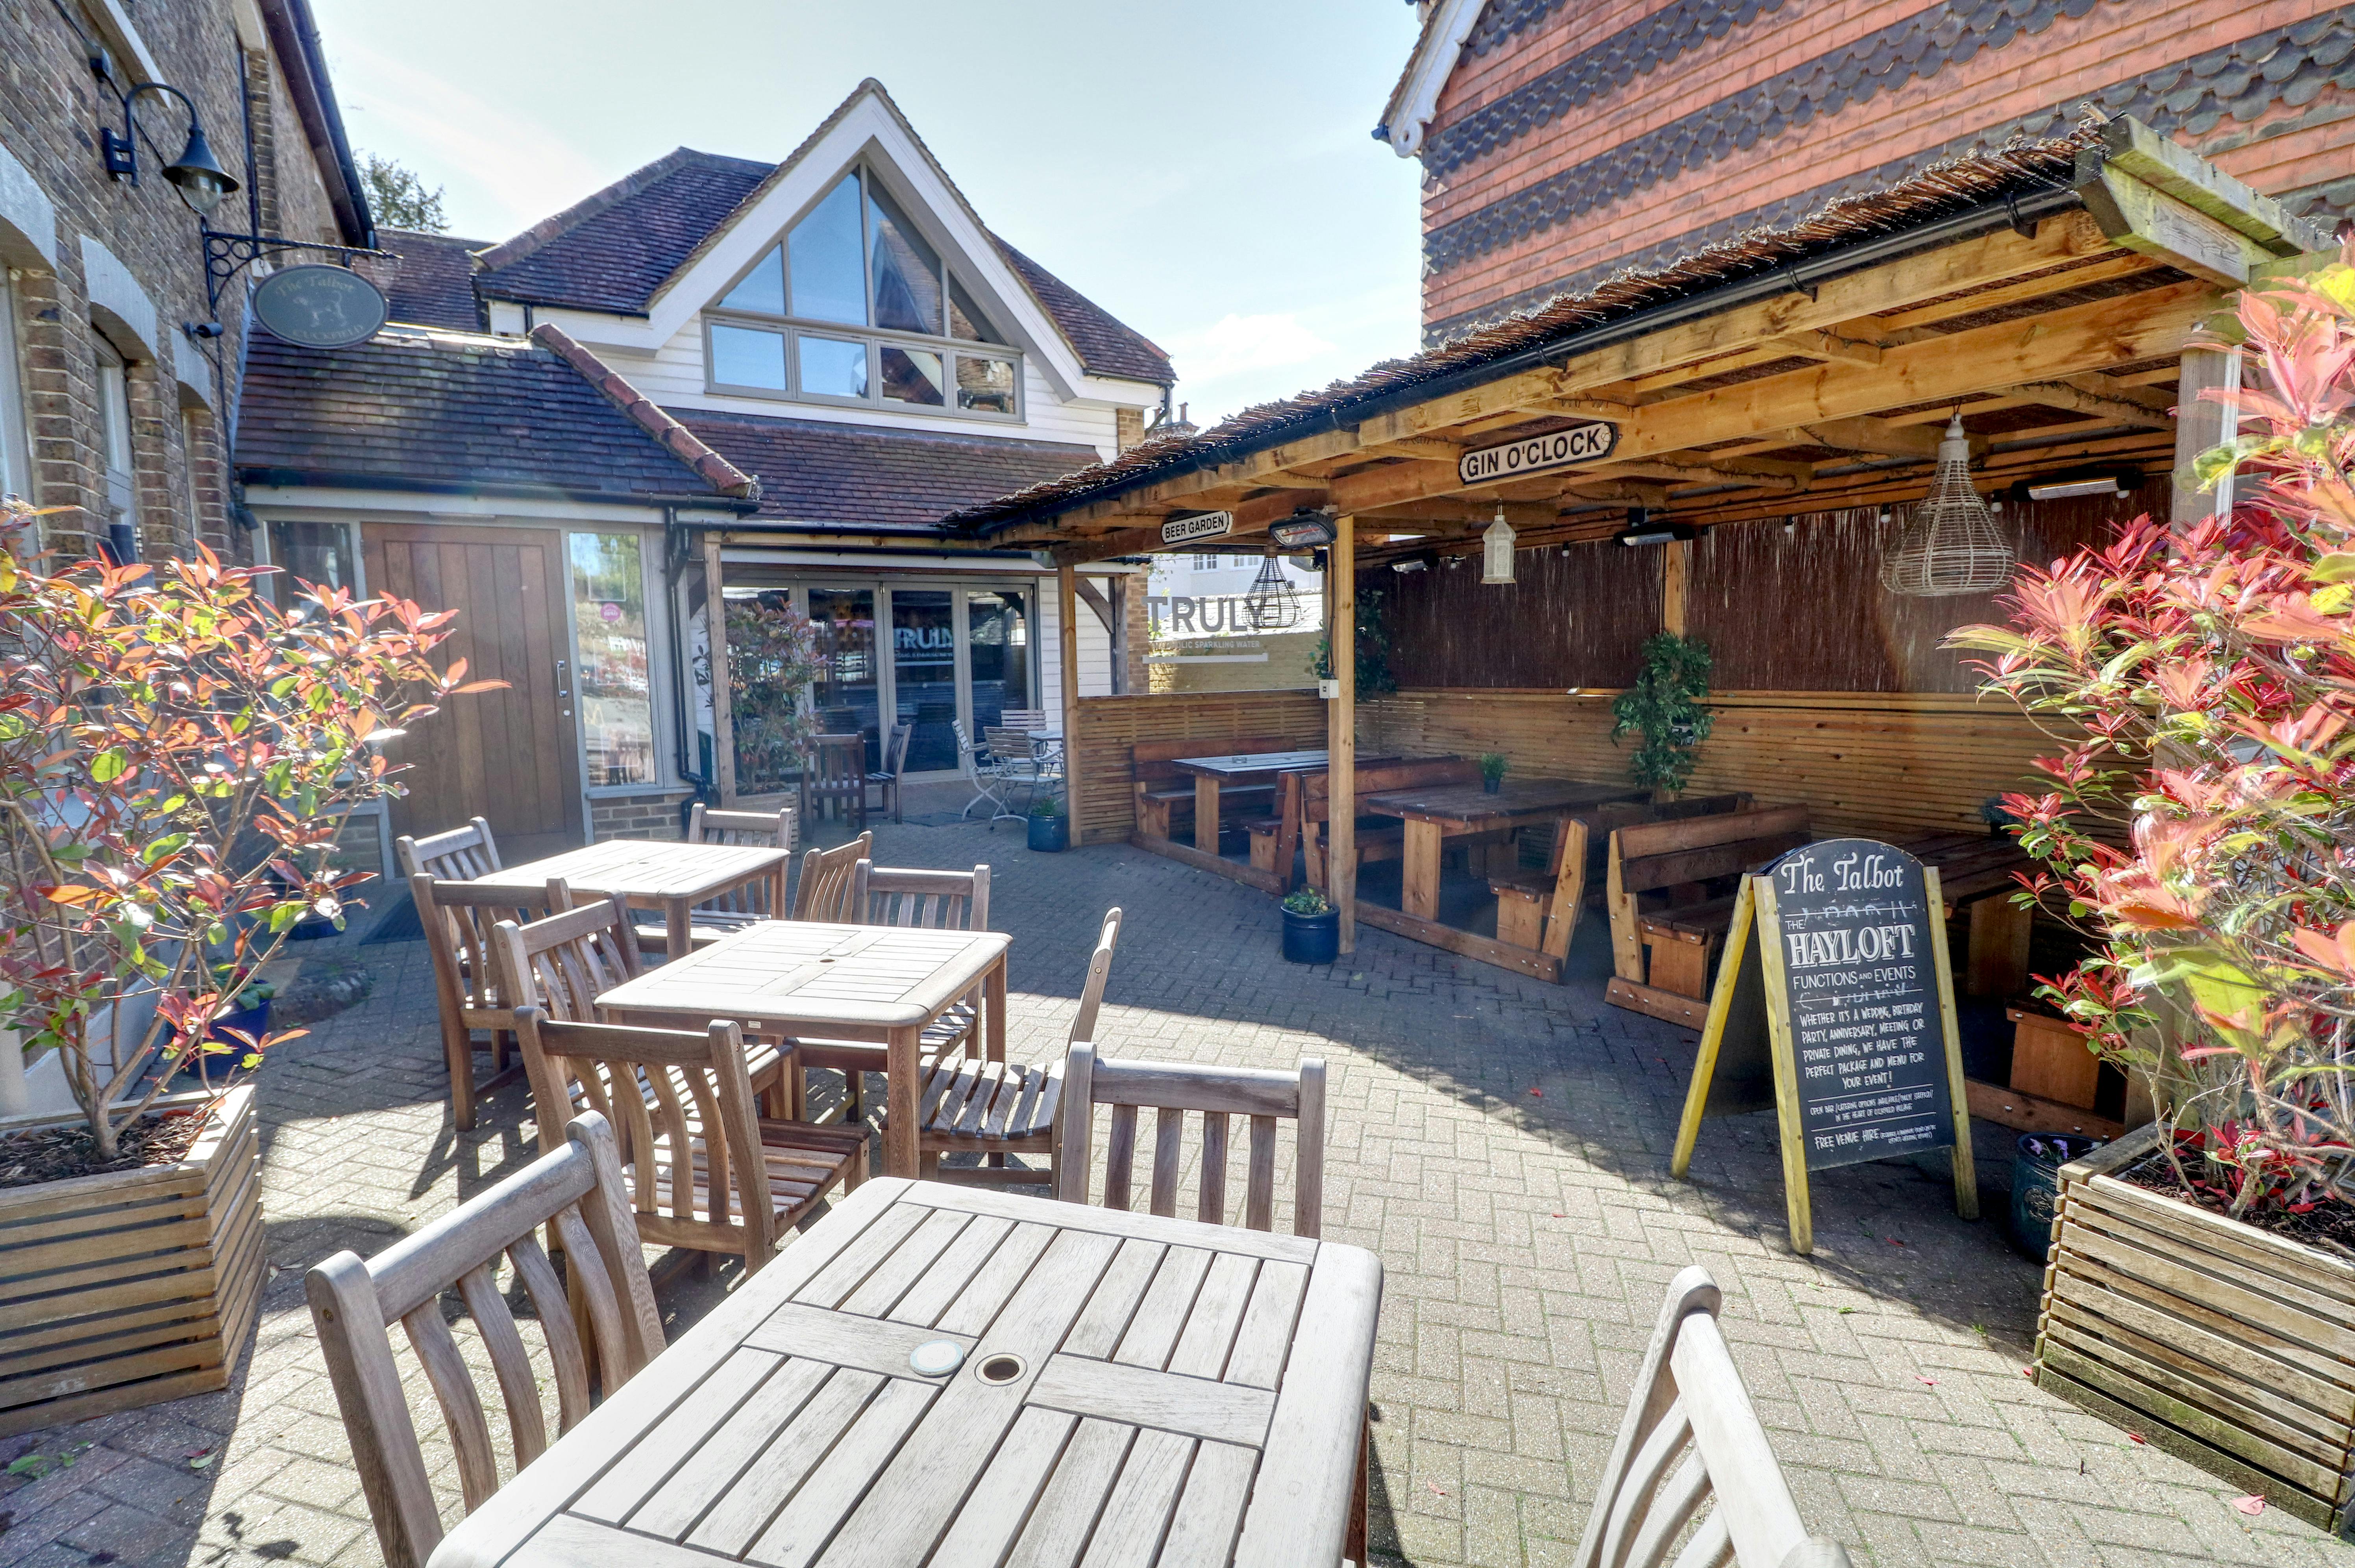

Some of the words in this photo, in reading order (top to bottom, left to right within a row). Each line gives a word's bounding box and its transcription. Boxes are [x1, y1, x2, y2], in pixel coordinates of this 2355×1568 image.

[1467, 451, 1499, 477] GIN
[1507, 428, 1601, 469] O'CLOCK
[1165, 523, 1186, 538] BEER
[1188, 515, 1224, 533] GARDEN
[1141, 596, 1268, 632] TRULY
[1195, 641, 1235, 649] SPARKLING
[1780, 853, 1825, 894] The
[1833, 851, 1904, 891] Talbot
[1785, 919, 1806, 930] THE
[1785, 923, 1916, 969] HAYLOFT
[1793, 970, 1858, 990] FUNCTIONS
[1858, 971, 1873, 981] AND
[1874, 965, 1917, 984] EVENTS
[1799, 1011, 1836, 1028] WHETHER
[1838, 1010, 1850, 1023] IT'S
[1853, 1008, 1860, 1021] A
[1892, 1002, 1924, 1017] BIRTHDAY
[1801, 1028, 1828, 1044] PARTY,
[1830, 1023, 1878, 1041] ANNIVERSARY,
[1879, 1020, 1909, 1035] MEETING
[1912, 1018, 1926, 1032] OR
[1802, 1047, 1831, 1063] PRIVATE
[1833, 1043, 1861, 1059] DINING,
[1862, 1041, 1874, 1054] WE
[1876, 1038, 1898, 1052] HAVE
[1900, 1035, 1918, 1049] THE
[1804, 1064, 1835, 1080] PERFECT
[1837, 1060, 1868, 1075] PACKAGE
[1870, 1057, 1885, 1070] AND
[1886, 1054, 1907, 1068] MENU
[1909, 1052, 1925, 1064] FOR
[1841, 1076, 1862, 1090] YOUR
[1810, 1106, 1824, 1116] OPEN
[1835, 1114, 1841, 1122] IN
[1842, 1112, 1851, 1122] THE
[1851, 1109, 1867, 1119] HEART
[1867, 1108, 1874, 1117] OF
[1814, 1135, 1835, 1150] FREE
[1835, 1131, 1860, 1146] VENUE
[1861, 1128, 1880, 1142] HIRE
